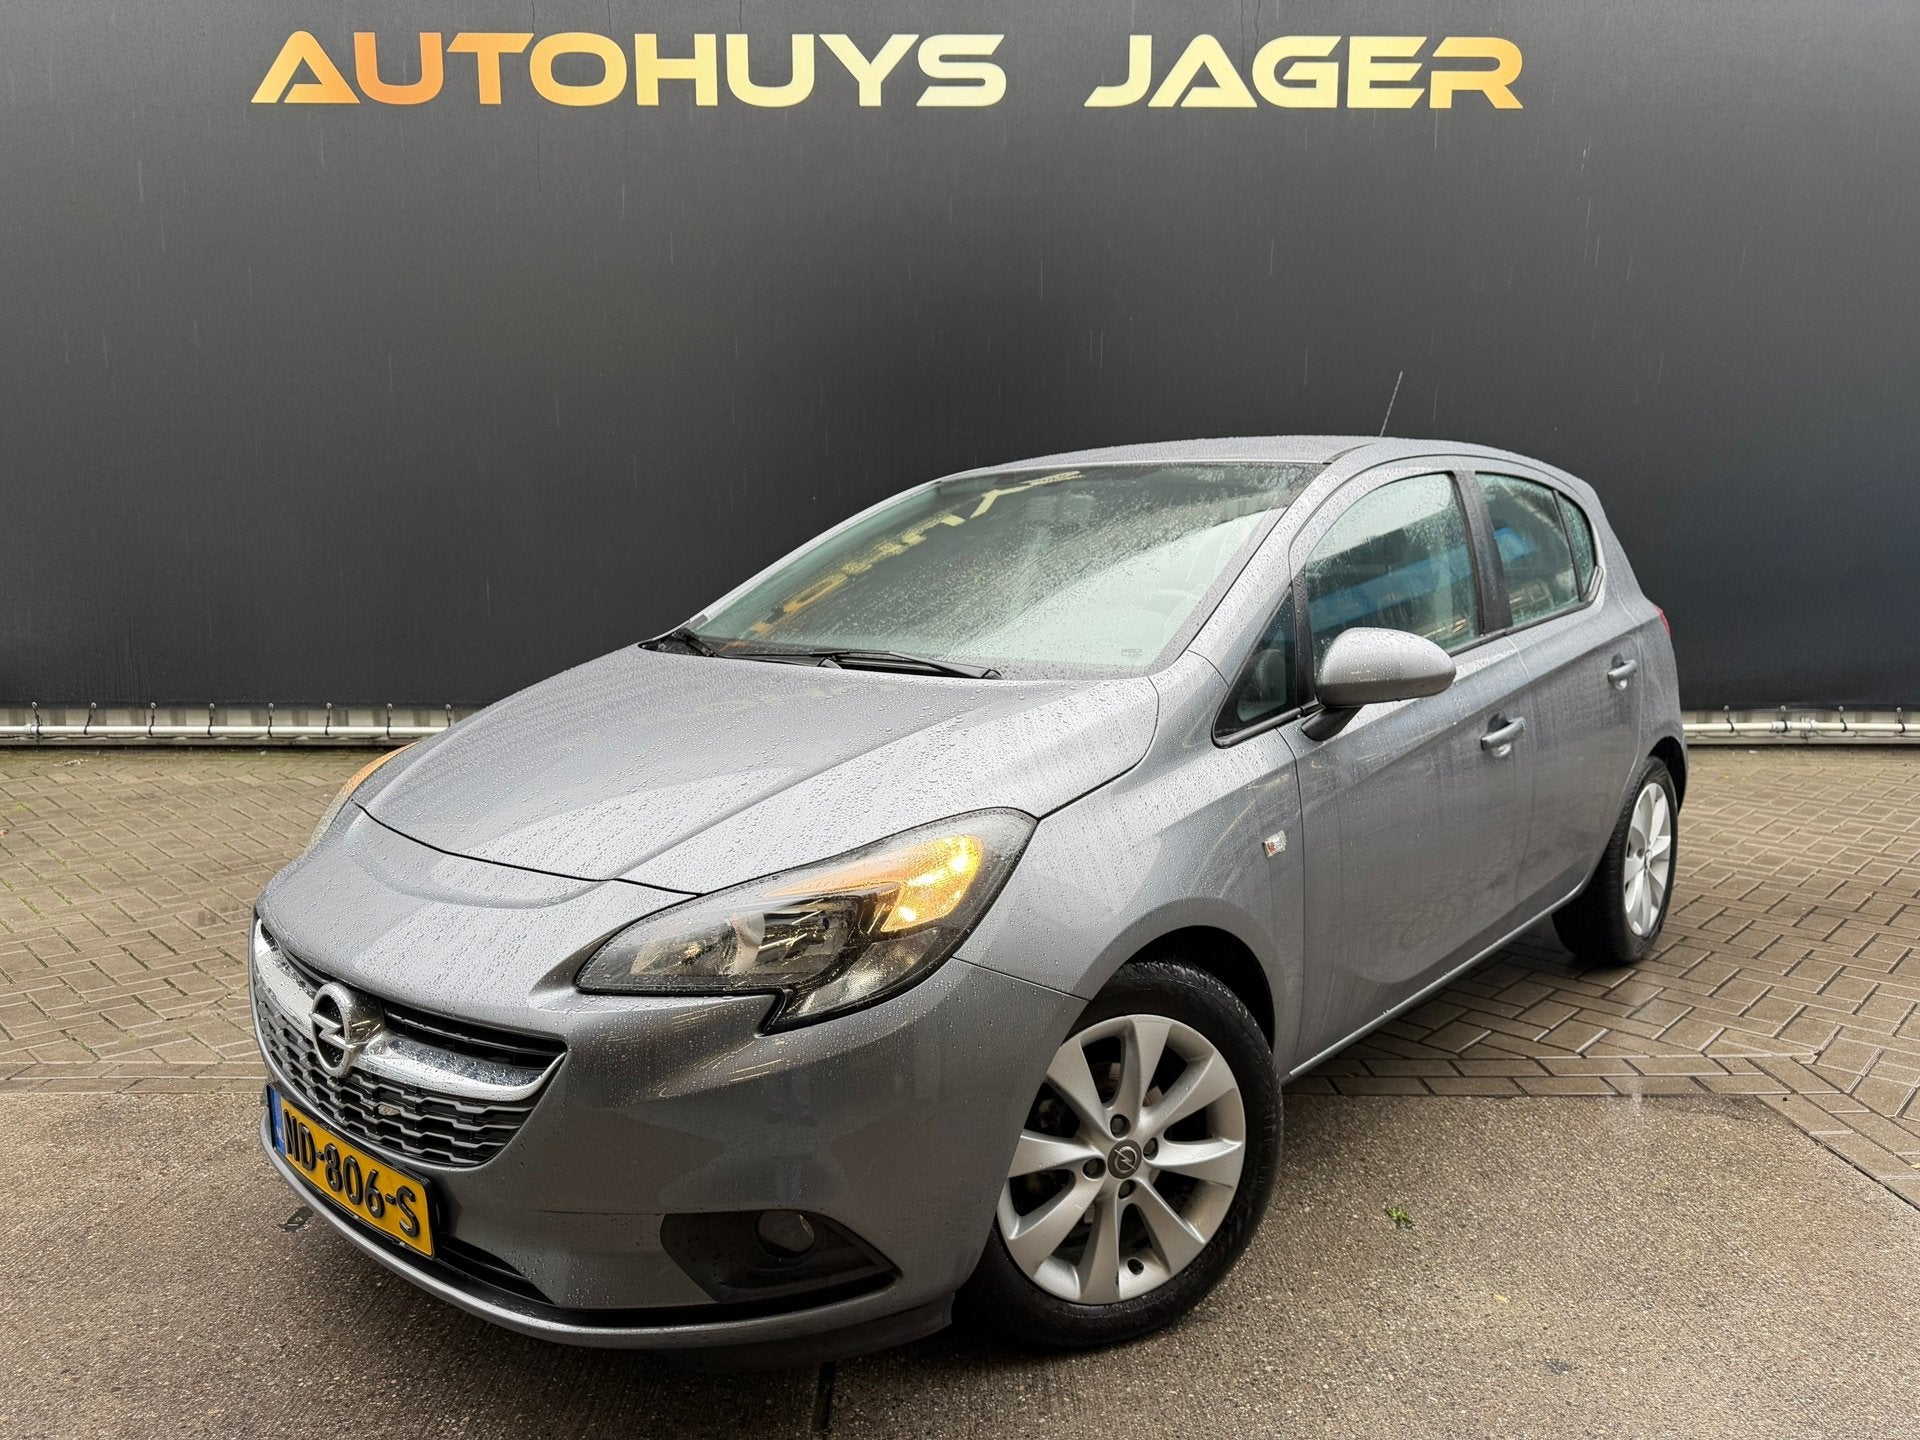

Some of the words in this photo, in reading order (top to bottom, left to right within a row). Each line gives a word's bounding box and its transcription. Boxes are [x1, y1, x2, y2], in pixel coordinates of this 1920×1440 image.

[251, 30, 1007, 108] AUTOHUYS
[1084, 33, 1524, 109] JAGER
[283, 1108, 418, 1238] ND-806-S
